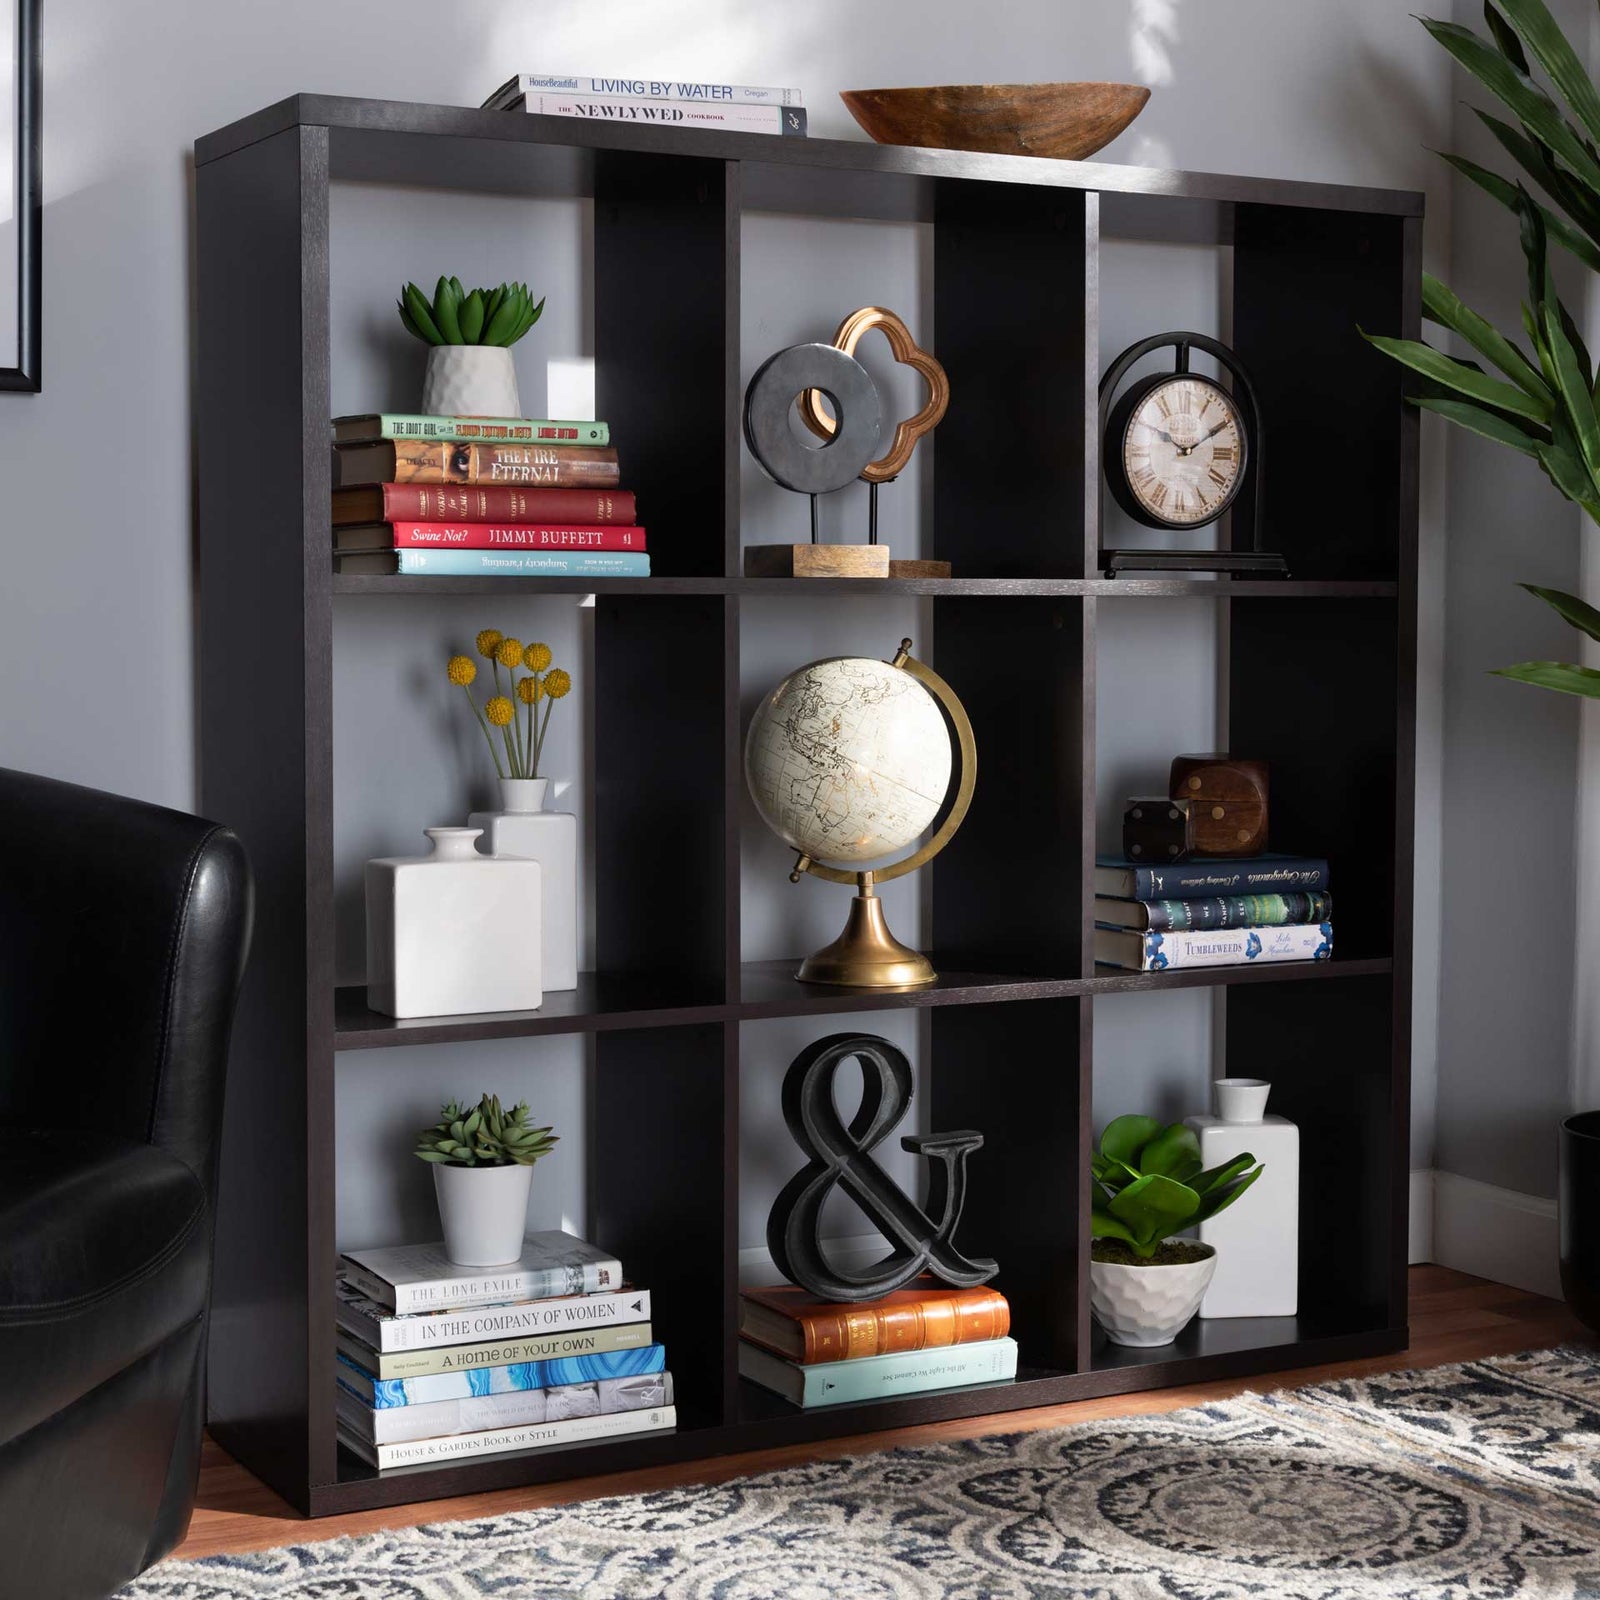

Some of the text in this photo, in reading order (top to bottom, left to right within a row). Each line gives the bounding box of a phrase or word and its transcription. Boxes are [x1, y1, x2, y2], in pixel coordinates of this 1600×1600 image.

[591, 78, 645, 95] LIVING
[650, 82, 672, 96] BY
[677, 83, 733, 100] WATER
[574, 104, 684, 121] NEWLYWED
[687, 113, 725, 121] COOKBOOK
[393, 422, 404, 434] THE
[405, 422, 422, 435] IDIOT
[424, 423, 438, 436] GIRL
[494, 448, 559, 465] THE FIRE
[411, 528, 604, 545] Swine Not? JIMMY BUFFETT
[1183, 902, 1192, 925] LIGHT
[1203, 906, 1209, 918] WE
[1185, 942, 1242, 956] TUMBLEWEEDS
[411, 1287, 437, 1301] THE
[443, 1281, 477, 1298] LONG
[484, 1278, 523, 1293] EXILE
[422, 1303, 616, 1339] IN THE COMPANY OF WOMEN
[441, 1356, 453, 1367] A
[503, 1346, 520, 1359] OF
[562, 1337, 595, 1352] OWN
[391, 1448, 425, 1459] HOUSE
[427, 1446, 436, 1455] &
[439, 1440, 480, 1452] GARDEN
[483, 1437, 512, 1447] BOOK
[529, 1429, 559, 1440] STYLE
